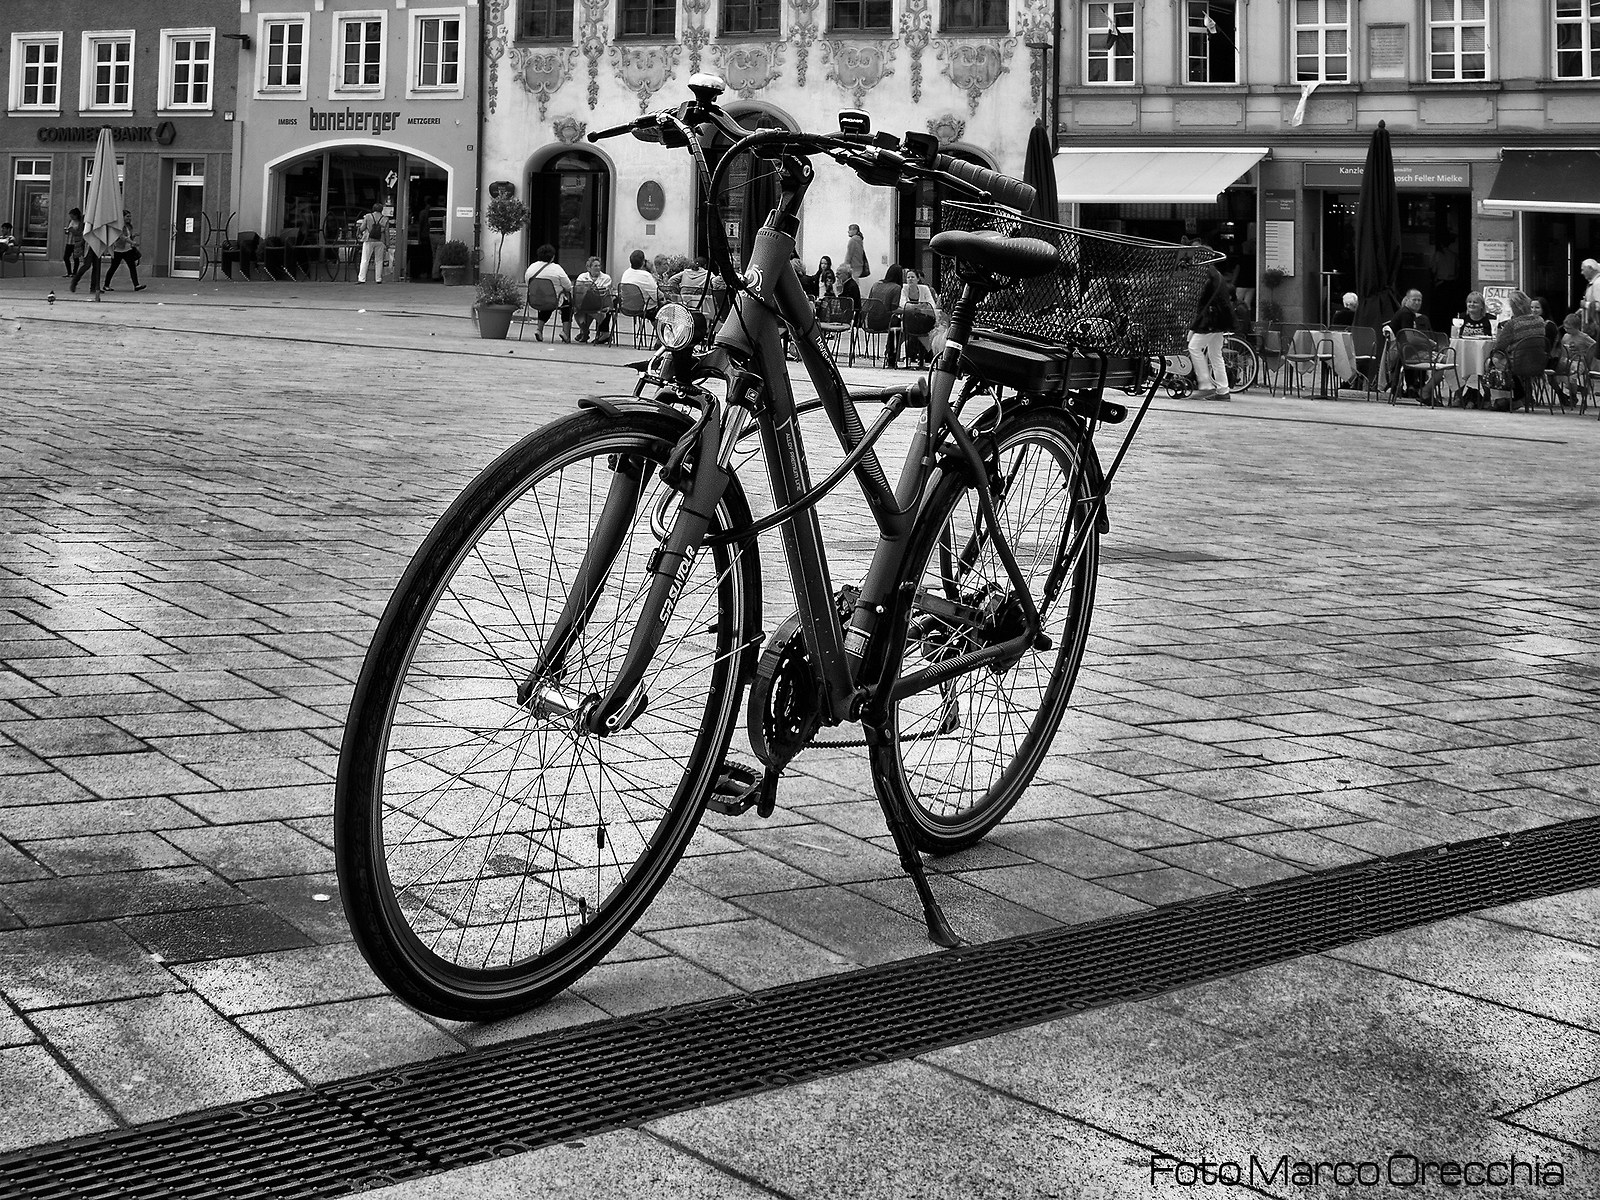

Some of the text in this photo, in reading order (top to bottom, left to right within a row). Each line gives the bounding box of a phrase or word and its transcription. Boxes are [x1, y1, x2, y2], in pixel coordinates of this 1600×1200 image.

[309, 106, 400, 135] boneberger
[407, 117, 441, 125] METZGEREI
[1339, 166, 1364, 175] Kanzle
[1414, 174, 1435, 182] Feller
[668, 544, 696, 604] SUNTOUR
